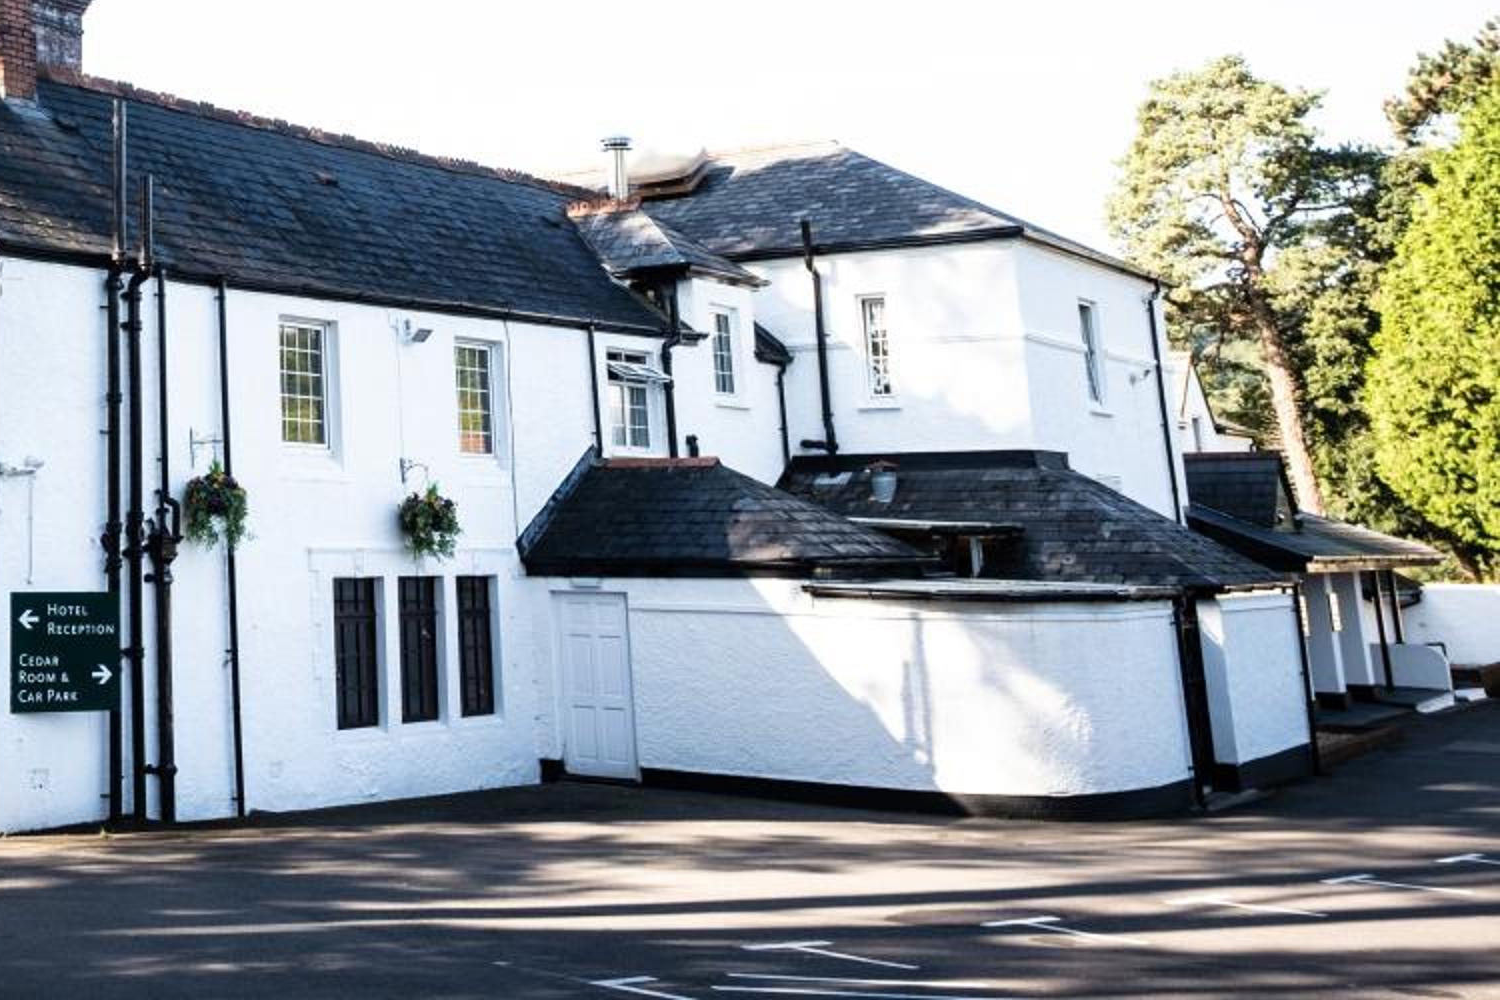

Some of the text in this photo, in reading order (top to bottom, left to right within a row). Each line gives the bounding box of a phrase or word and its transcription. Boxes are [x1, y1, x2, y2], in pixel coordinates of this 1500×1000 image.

[47, 603, 88, 616] HOTEL
[47, 622, 115, 635] RECEPTION
[19, 653, 59, 667] CEDAR
[18, 670, 70, 683] ROOM &
[18, 689, 79, 703] CAR PARK
